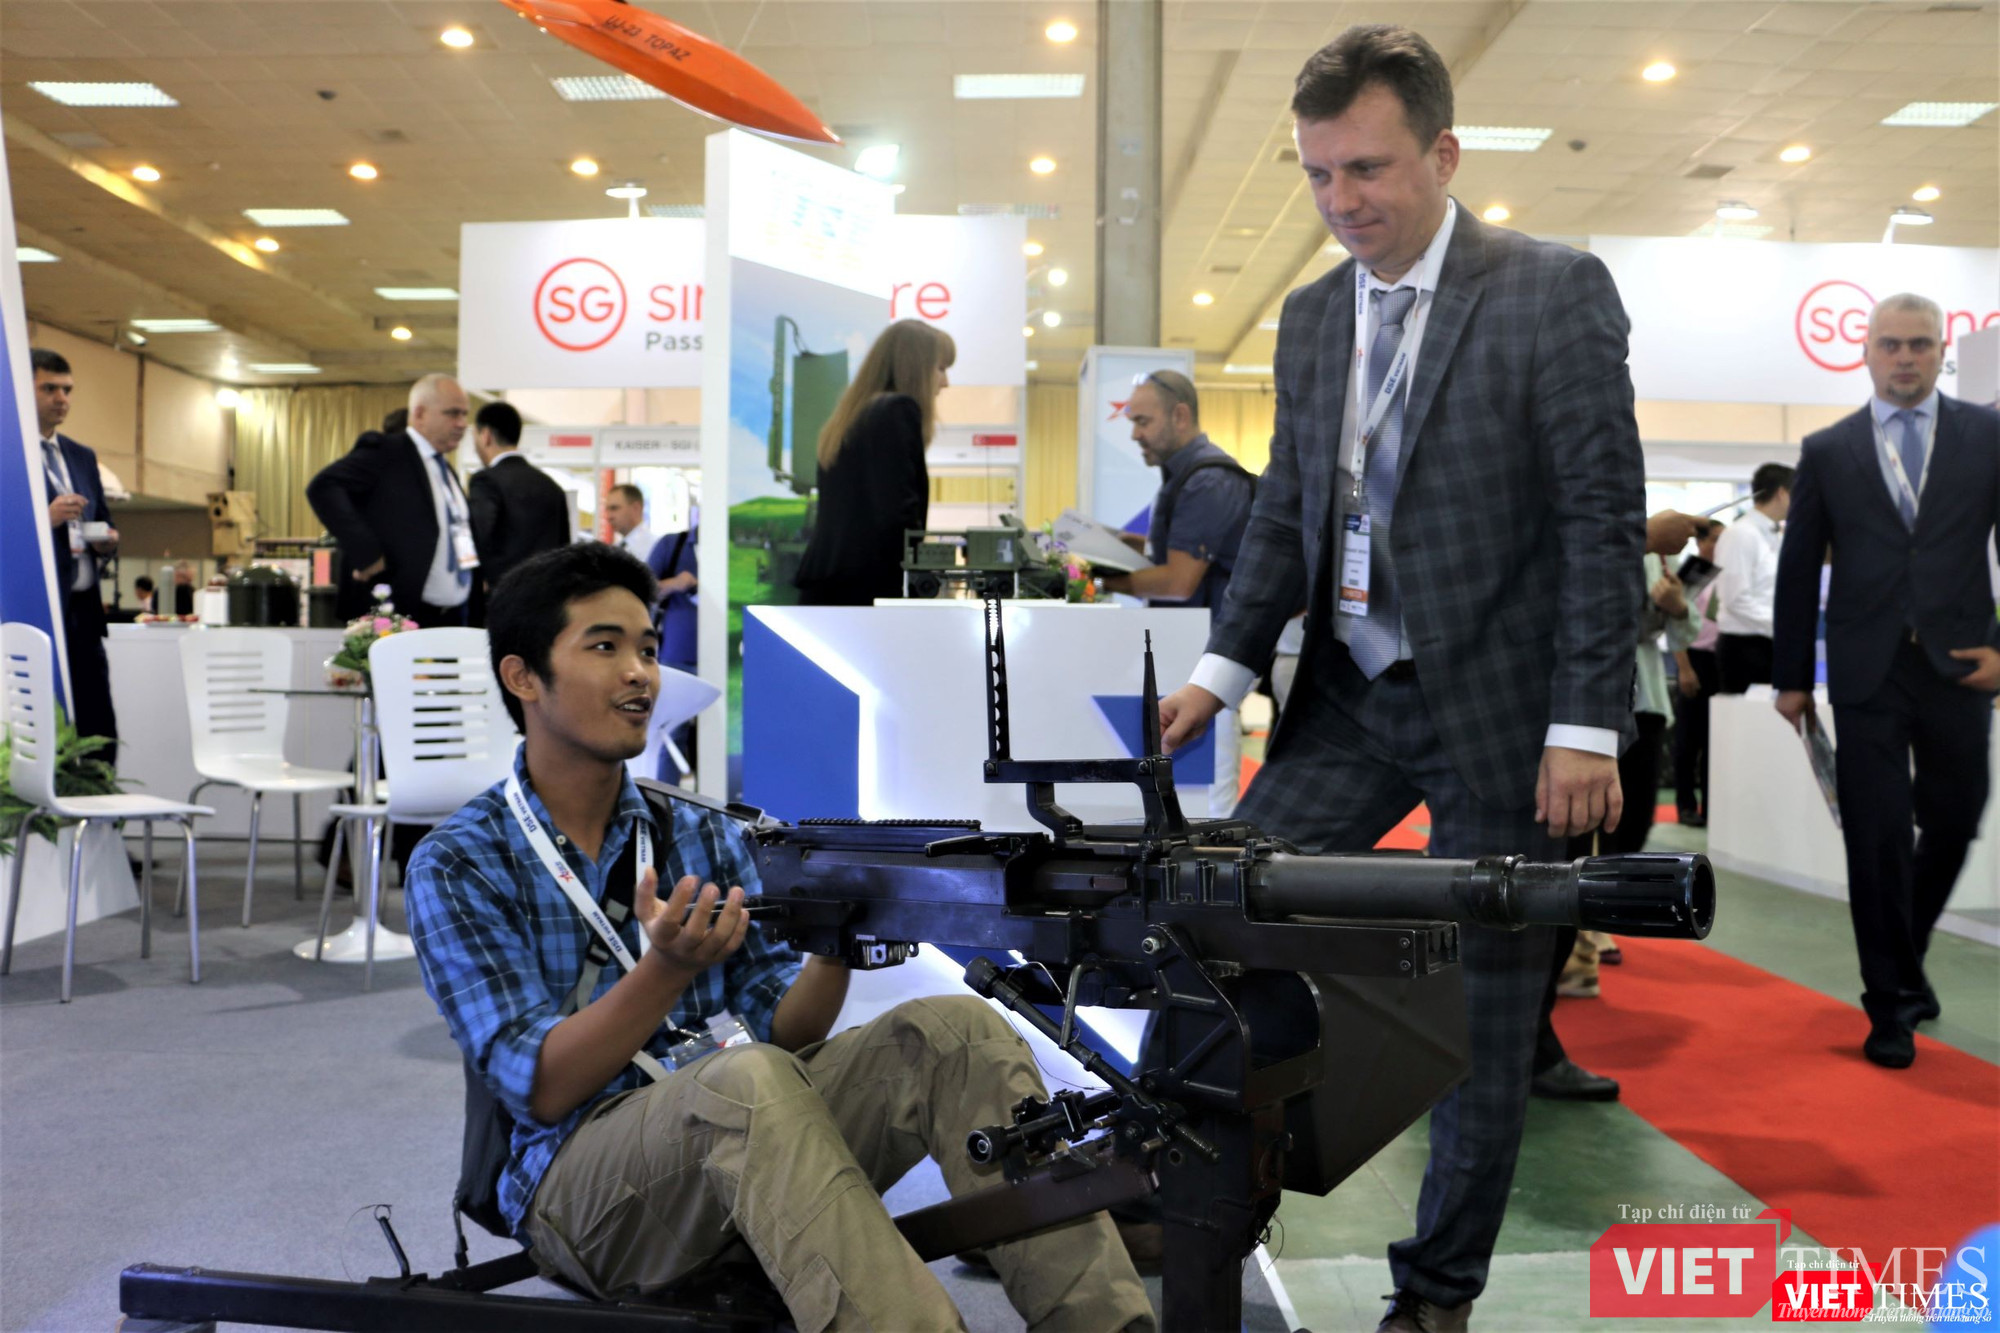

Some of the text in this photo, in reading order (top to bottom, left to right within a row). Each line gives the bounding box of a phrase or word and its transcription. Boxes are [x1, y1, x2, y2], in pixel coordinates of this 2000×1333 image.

[644, 34, 691, 62] TOPAZ
[548, 285, 615, 323] SG
[523, 814, 538, 834] DSE
[608, 935, 623, 953] DSE
